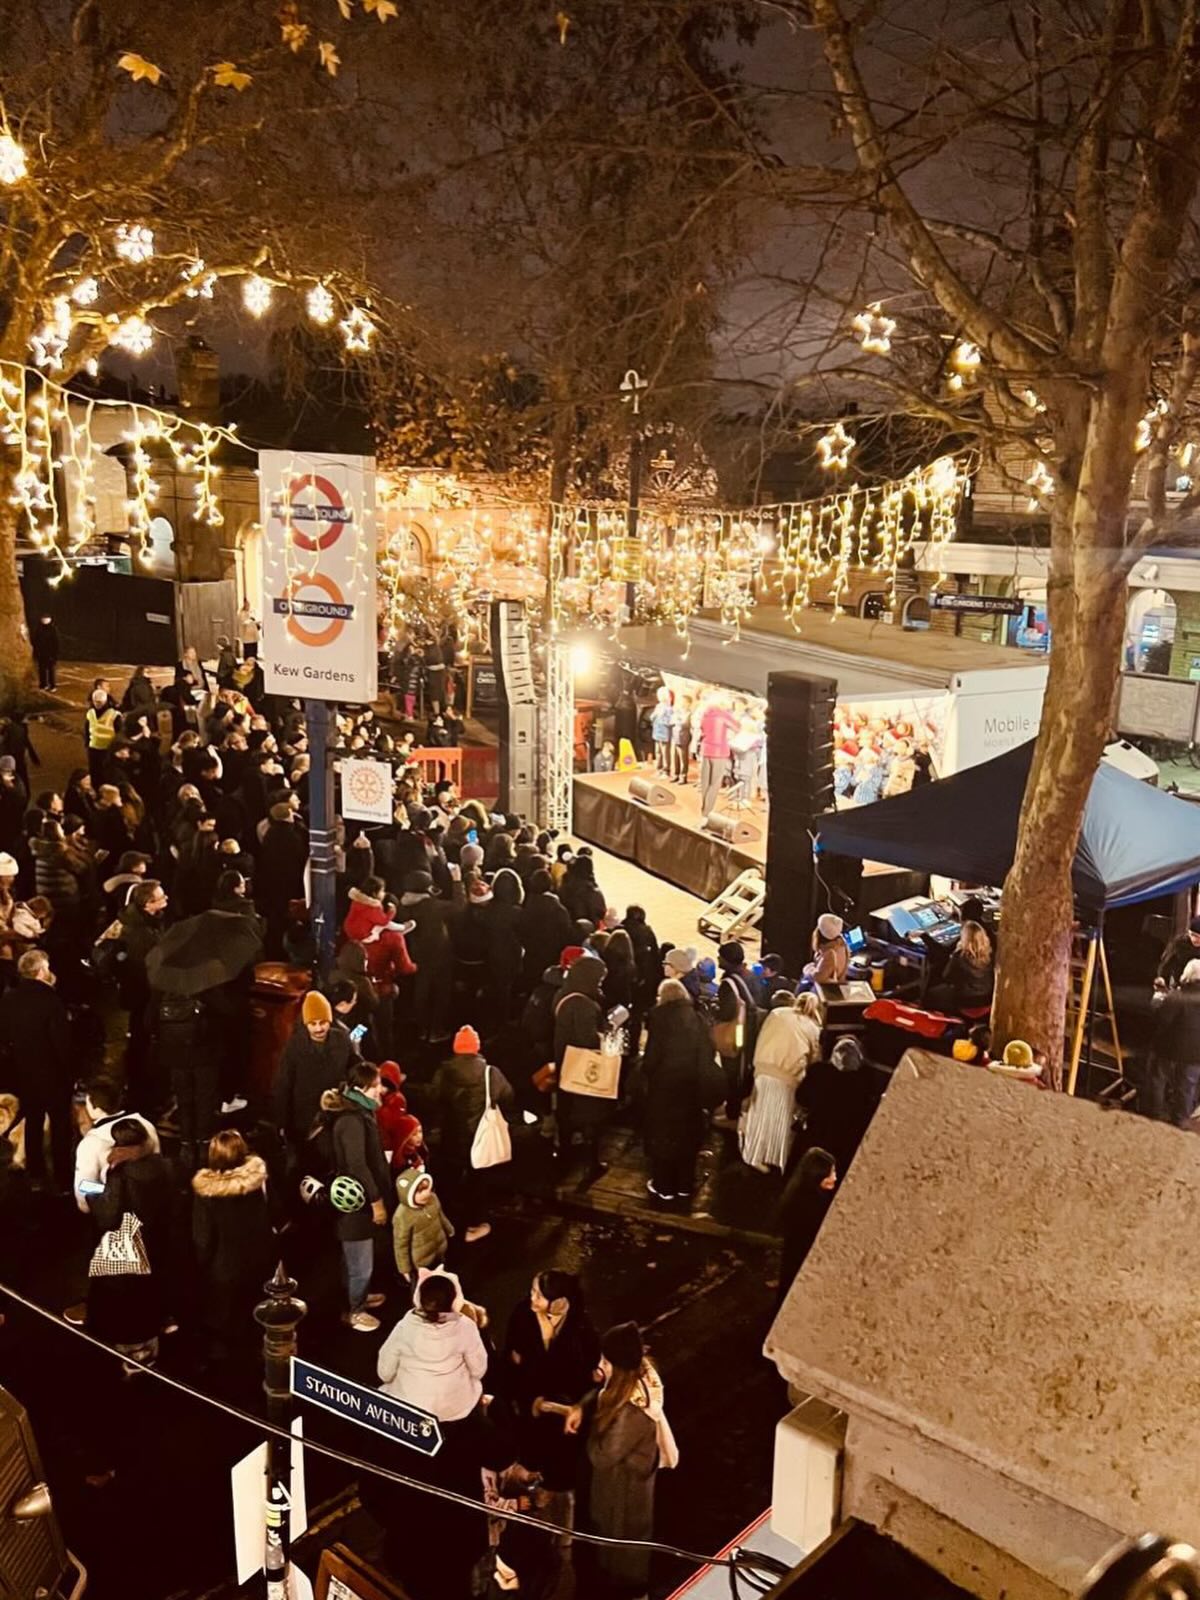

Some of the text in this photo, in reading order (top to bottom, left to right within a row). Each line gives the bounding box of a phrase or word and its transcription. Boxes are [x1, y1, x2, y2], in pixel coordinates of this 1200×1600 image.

[279, 601, 348, 617] ORGROUND
[273, 663, 356, 683] Kew Gardens
[984, 715, 1030, 733] Mobile
[305, 1375, 419, 1438] STATION AVENUE
